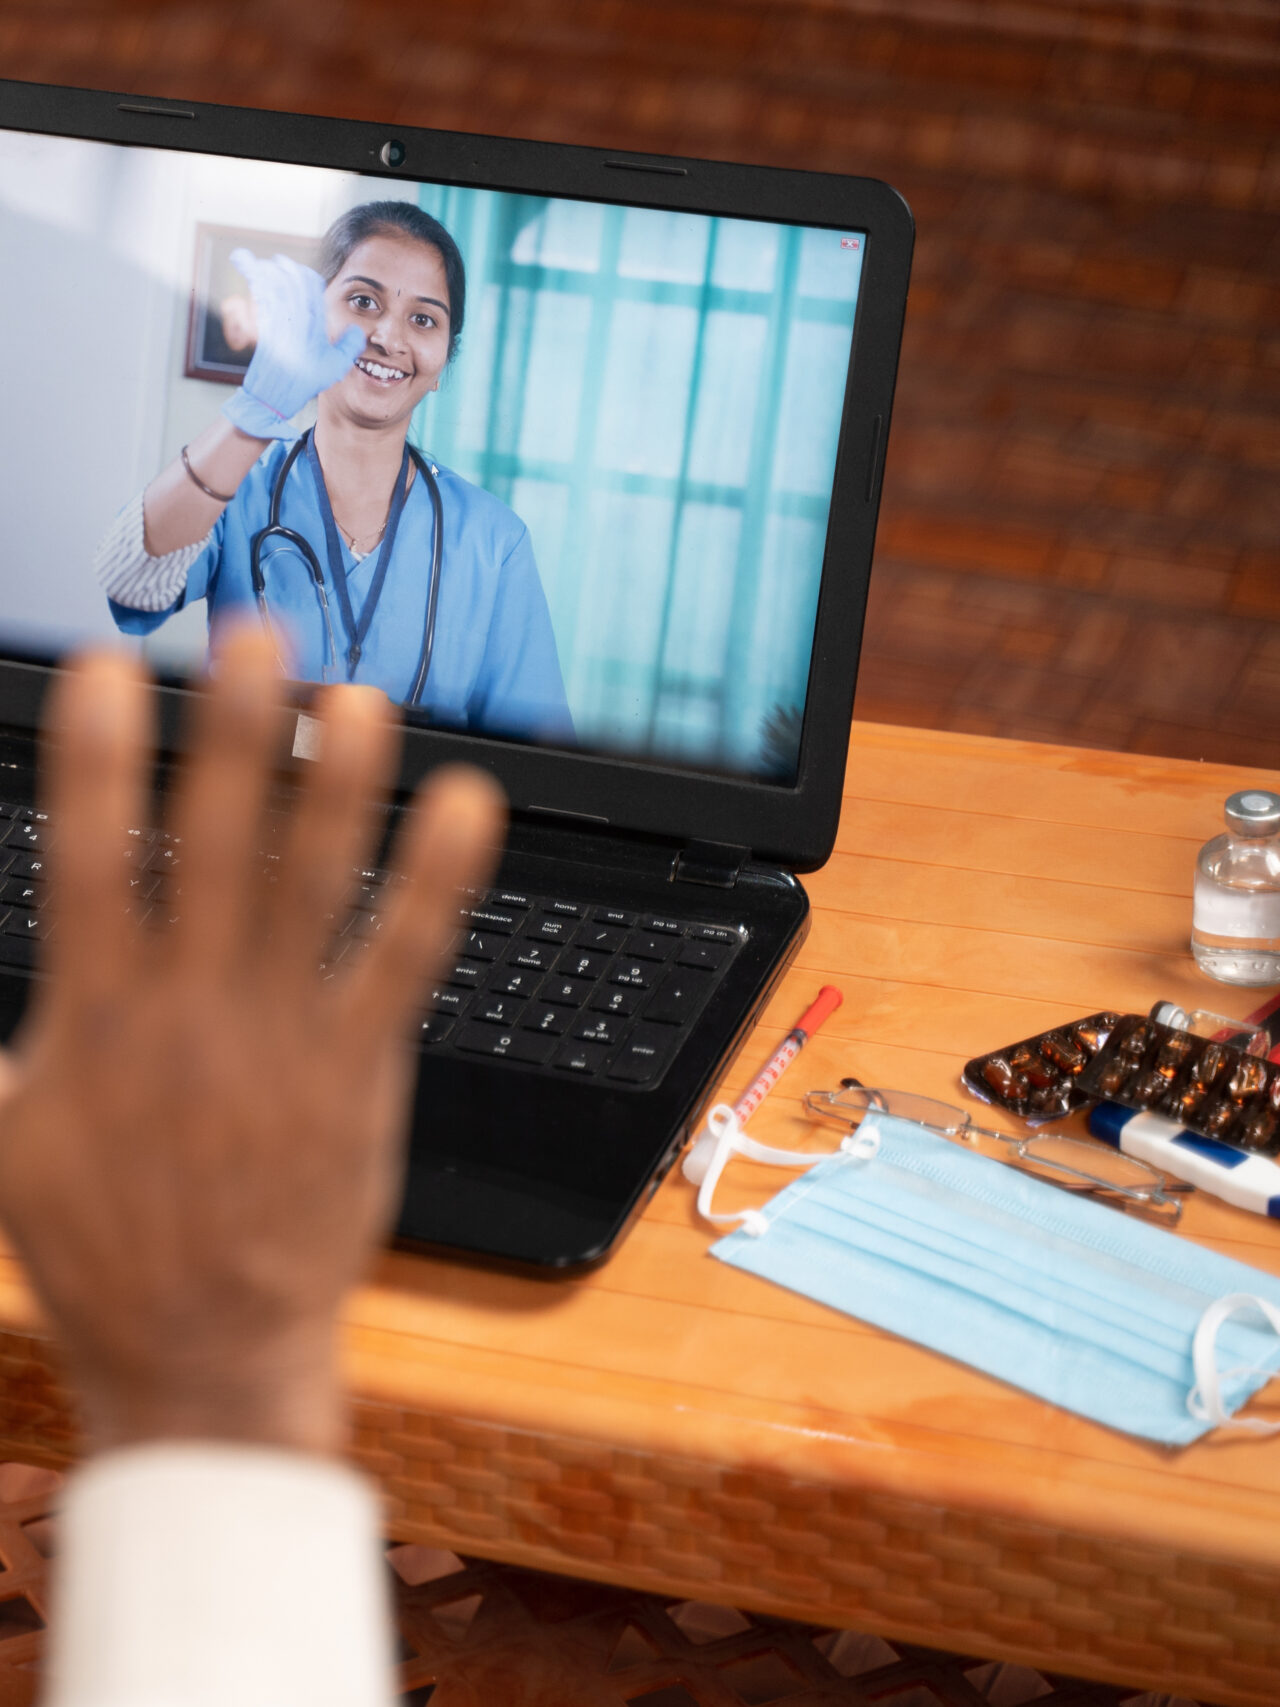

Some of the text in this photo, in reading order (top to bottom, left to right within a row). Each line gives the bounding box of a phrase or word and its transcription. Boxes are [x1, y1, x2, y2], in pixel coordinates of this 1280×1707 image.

[31, 862, 42, 870] R
[22, 889, 34, 897] F
[501, 893, 527, 903] delete
[554, 902, 577, 911] home
[470, 911, 513, 923] backspace
[27, 919, 38, 928] V
[543, 921, 562, 929] num
[652, 920, 665, 928] pg
[541, 926, 559, 934] lock
[703, 928, 715, 936] pg
[529, 950, 540, 958] 7
[517, 956, 541, 966] home
[580, 959, 590, 967] 8
[456, 967, 478, 975] enter
[631, 968, 640, 976] 9
[511, 977, 522, 985] 4
[562, 986, 573, 994] 5
[441, 995, 460, 1003] shift
[613, 994, 623, 1003] 6
[485, 1011, 503, 1019] end
[544, 1013, 555, 1022] 2
[596, 1023, 606, 1031] 3
[500, 1037, 511, 1046] 0
[632, 1046, 656, 1055] enter
